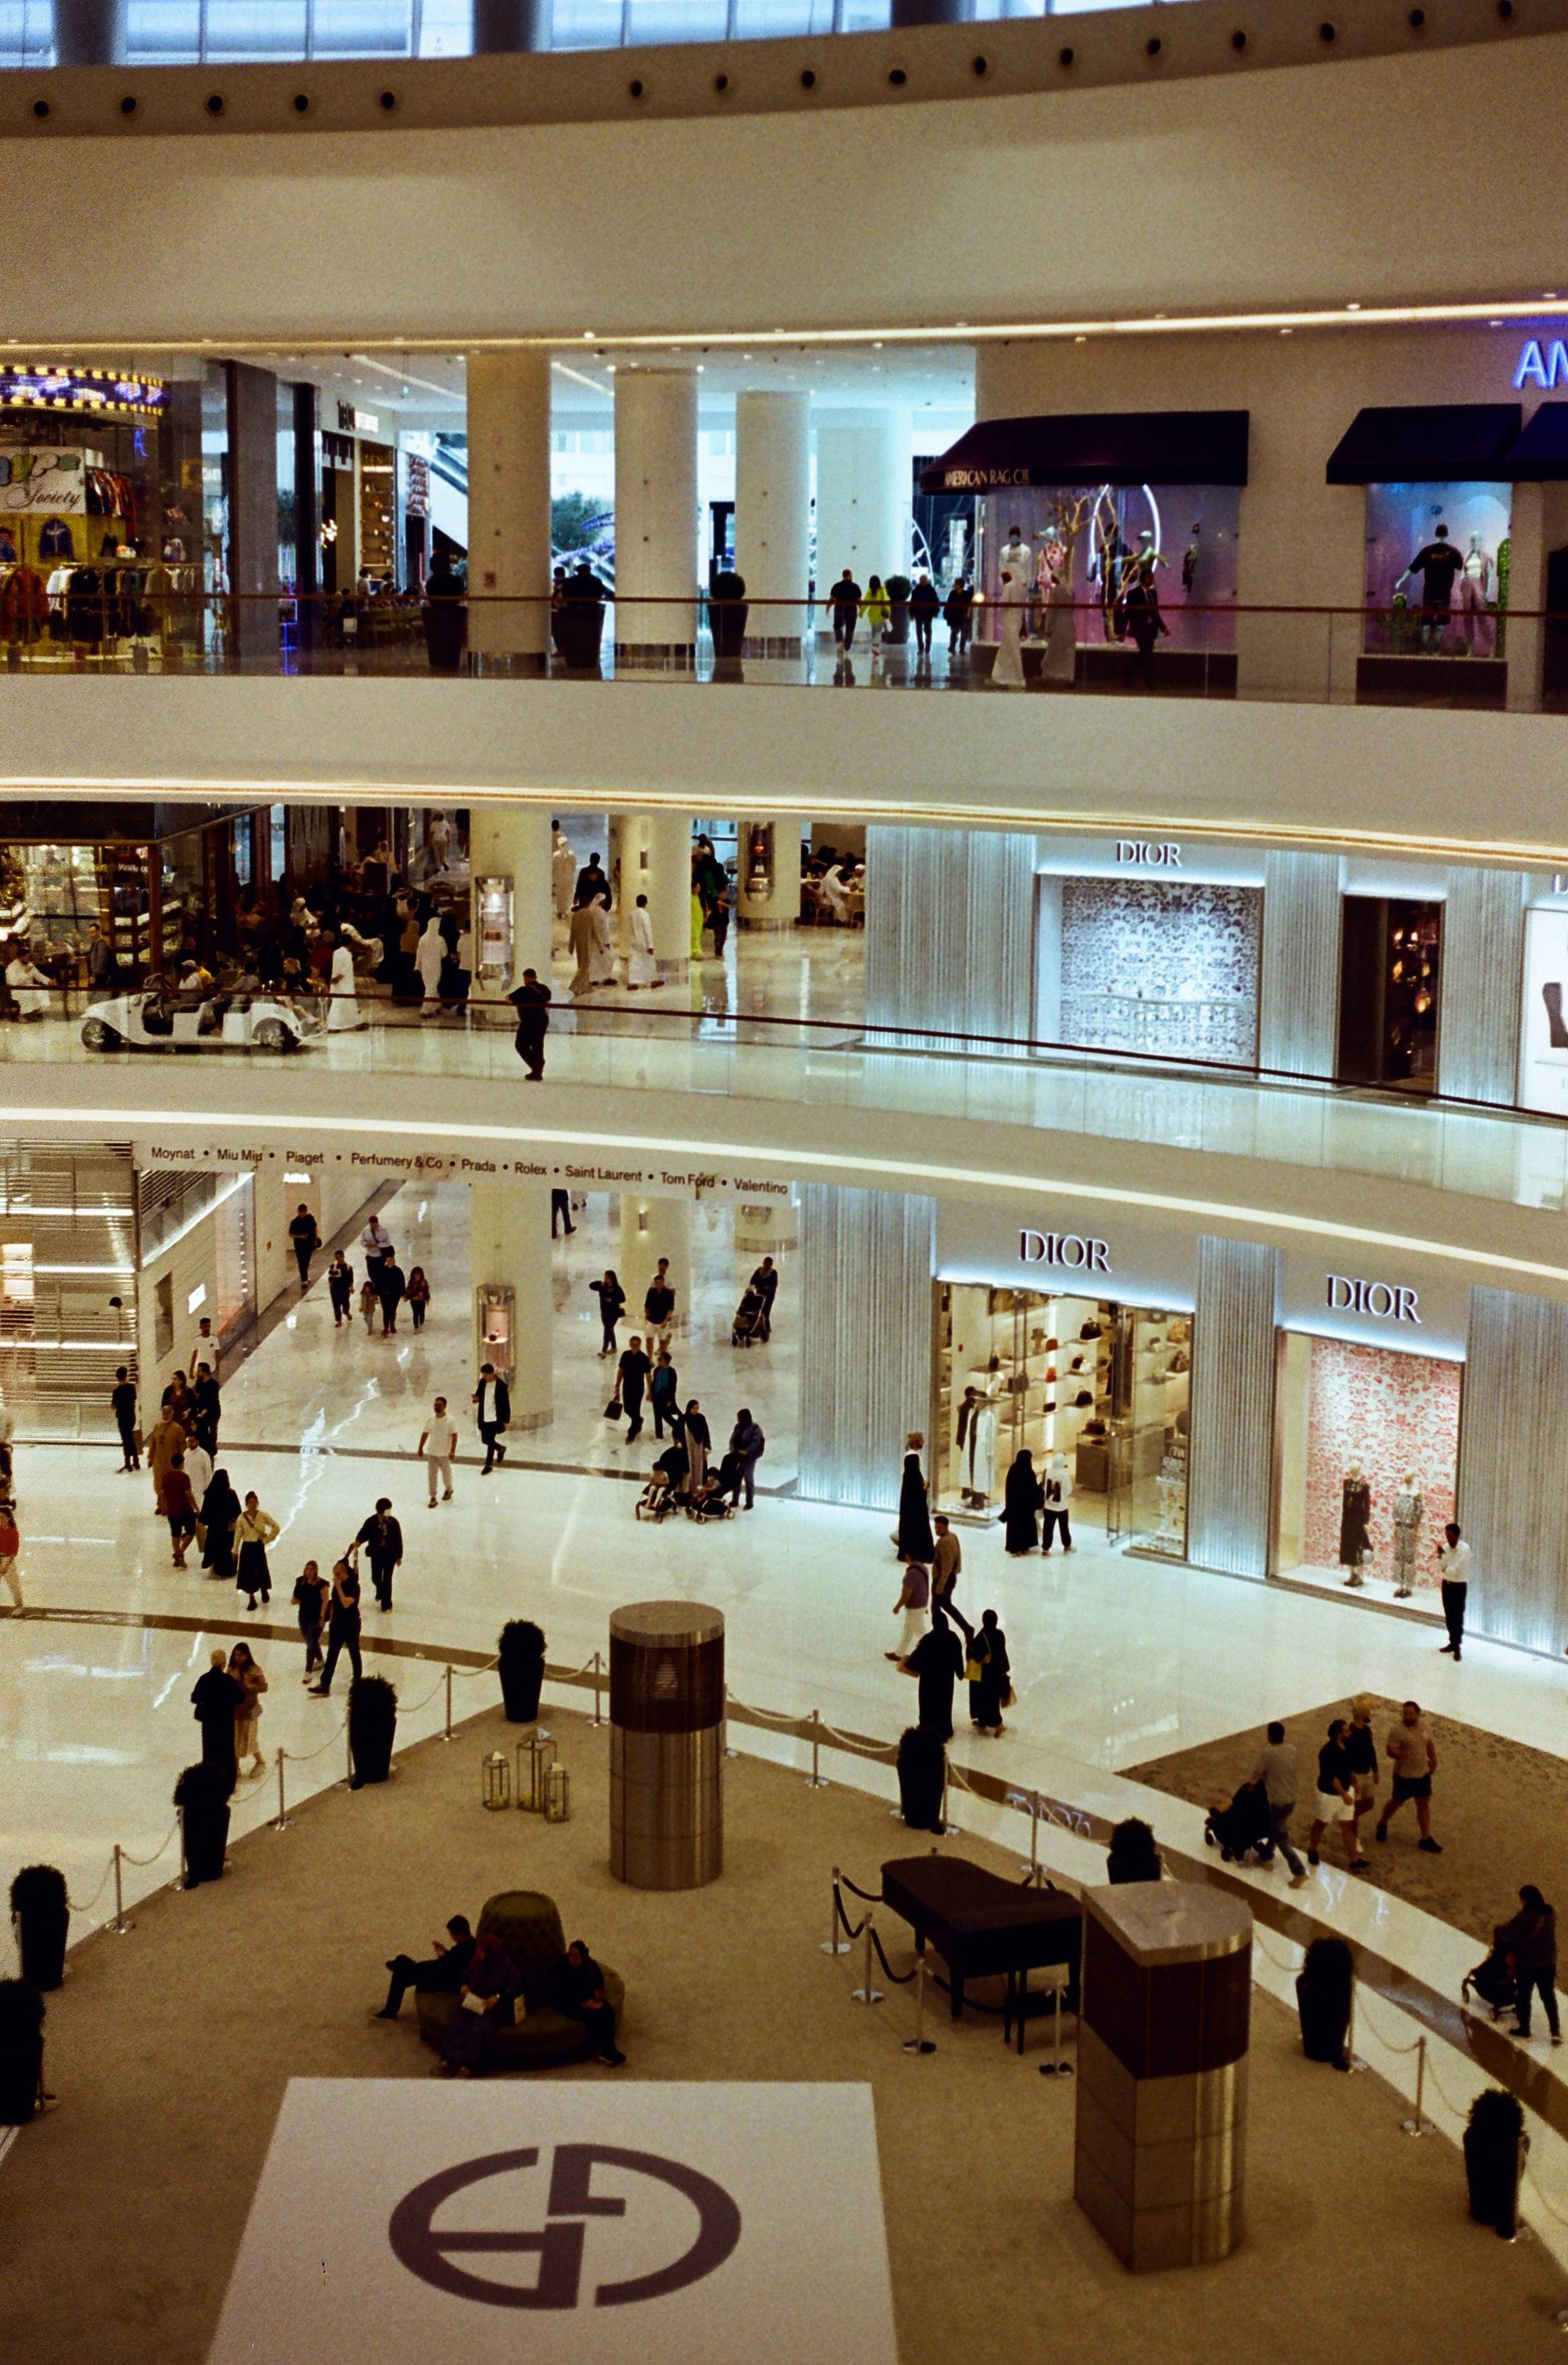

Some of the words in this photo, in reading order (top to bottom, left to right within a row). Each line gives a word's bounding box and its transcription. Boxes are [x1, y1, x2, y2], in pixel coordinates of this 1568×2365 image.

[990, 469, 1010, 484] RAG
[1116, 839, 1182, 867] DIOR
[151, 1147, 195, 1161] Moynat
[217, 1148, 239, 1161] Miu
[286, 1151, 324, 1166] Piaget
[351, 1152, 412, 1170] Perfumery
[415, 1155, 424, 1168] &
[426, 1156, 443, 1169] Co
[462, 1158, 496, 1172] Prada
[514, 1161, 547, 1175] Rolex
[565, 1164, 594, 1179] Saint
[598, 1168, 642, 1182] Laurent
[661, 1171, 685, 1185] Tom
[734, 1177, 788, 1194] Valentino
[1018, 1229, 1112, 1273] DIOR
[1325, 1274, 1422, 1324] DIOR
